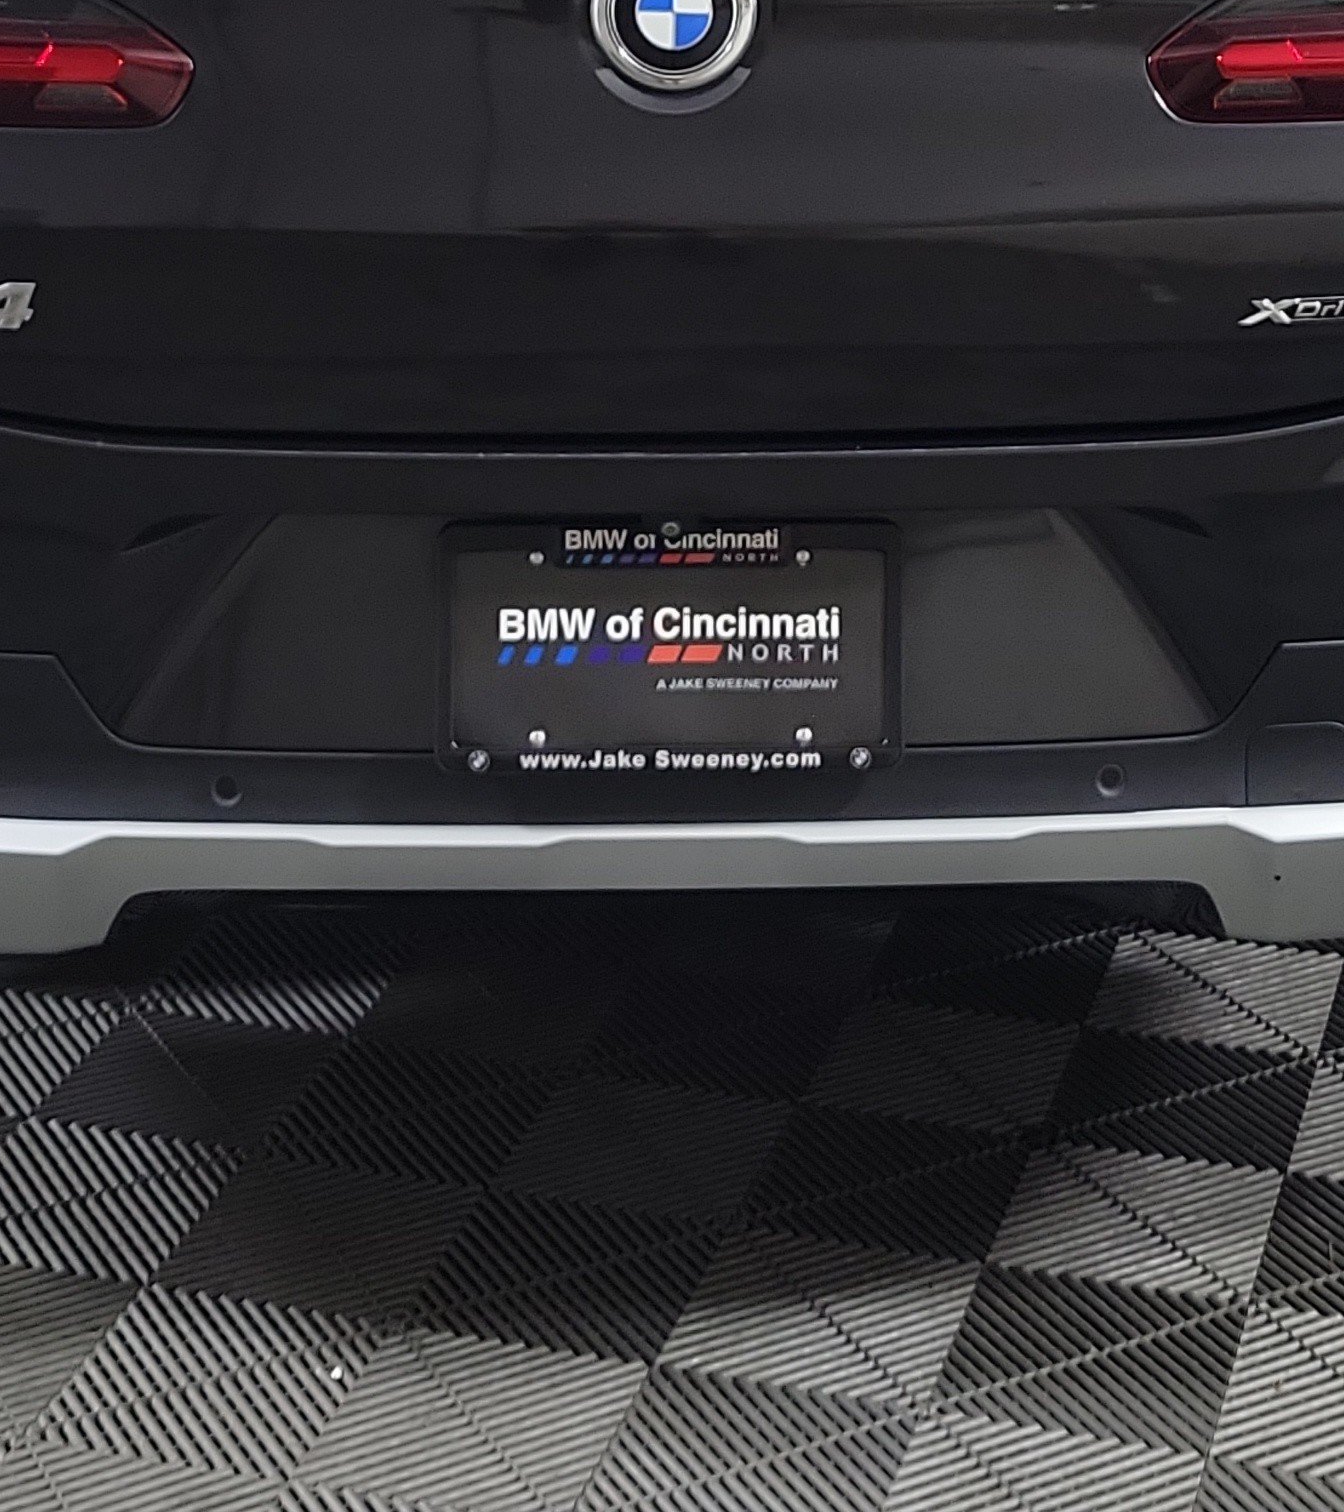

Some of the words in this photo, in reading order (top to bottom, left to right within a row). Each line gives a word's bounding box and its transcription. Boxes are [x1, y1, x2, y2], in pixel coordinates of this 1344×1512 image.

[564, 528, 628, 551] BMW
[722, 553, 780, 563] NORTH
[498, 608, 596, 641] BMW
[605, 607, 645, 641] of
[654, 606, 841, 641] Cincinnati
[726, 643, 840, 663] NORTH
[669, 678, 705, 691] JAKE
[706, 678, 771, 691] SWEENEY
[773, 678, 839, 691] COMPANY
[519, 750, 646, 769] www.Jake
[655, 749, 822, 772] Sweeney.com
